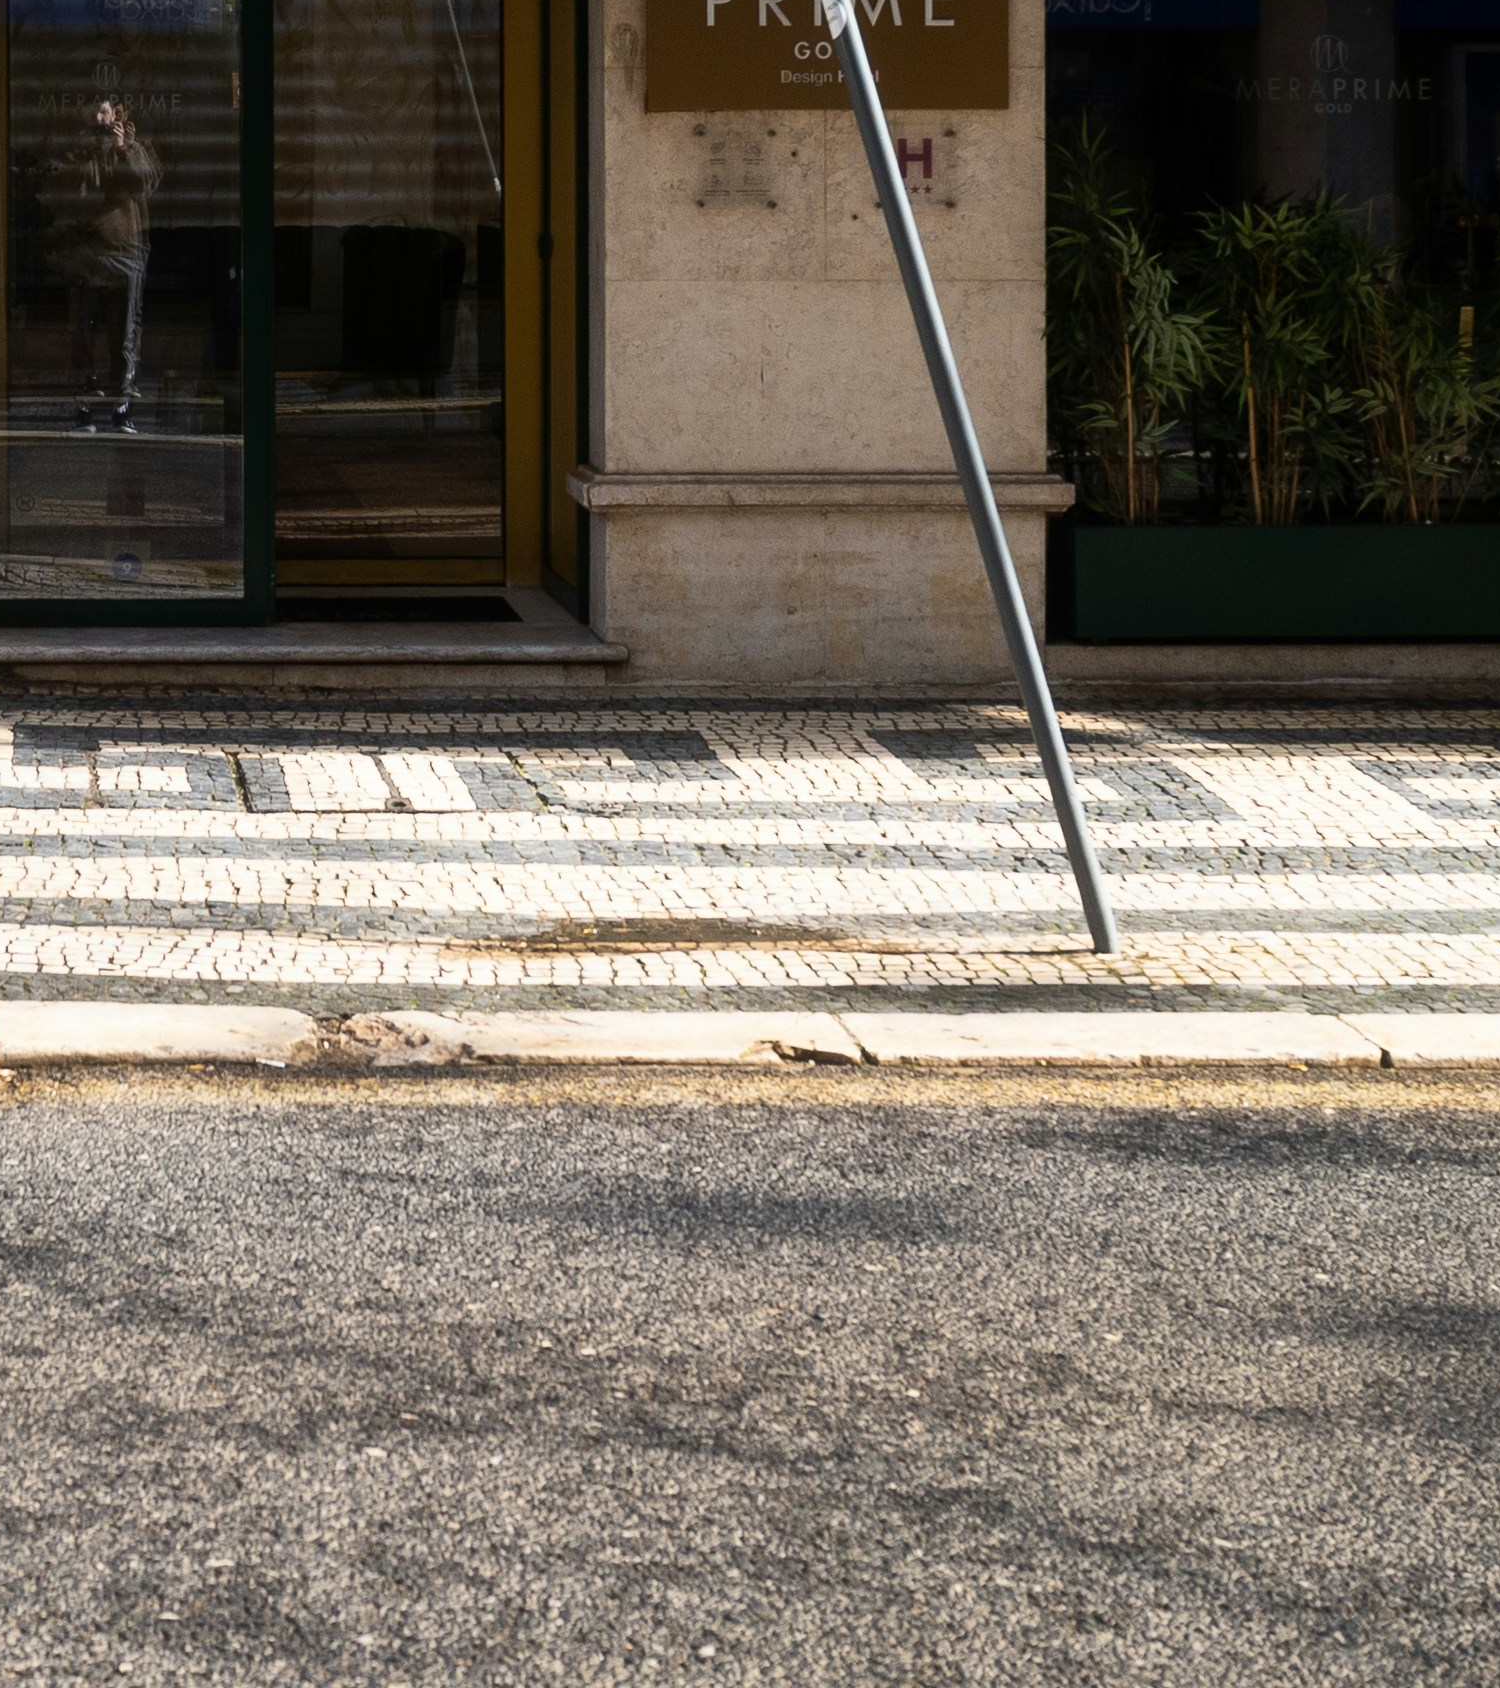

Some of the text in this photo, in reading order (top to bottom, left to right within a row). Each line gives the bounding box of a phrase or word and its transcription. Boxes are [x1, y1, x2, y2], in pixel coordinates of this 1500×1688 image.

[794, 41, 833, 60] GO
[781, 69, 833, 87] Design
[1314, 103, 1353, 115] GOLD
[897, 138, 933, 179] H
